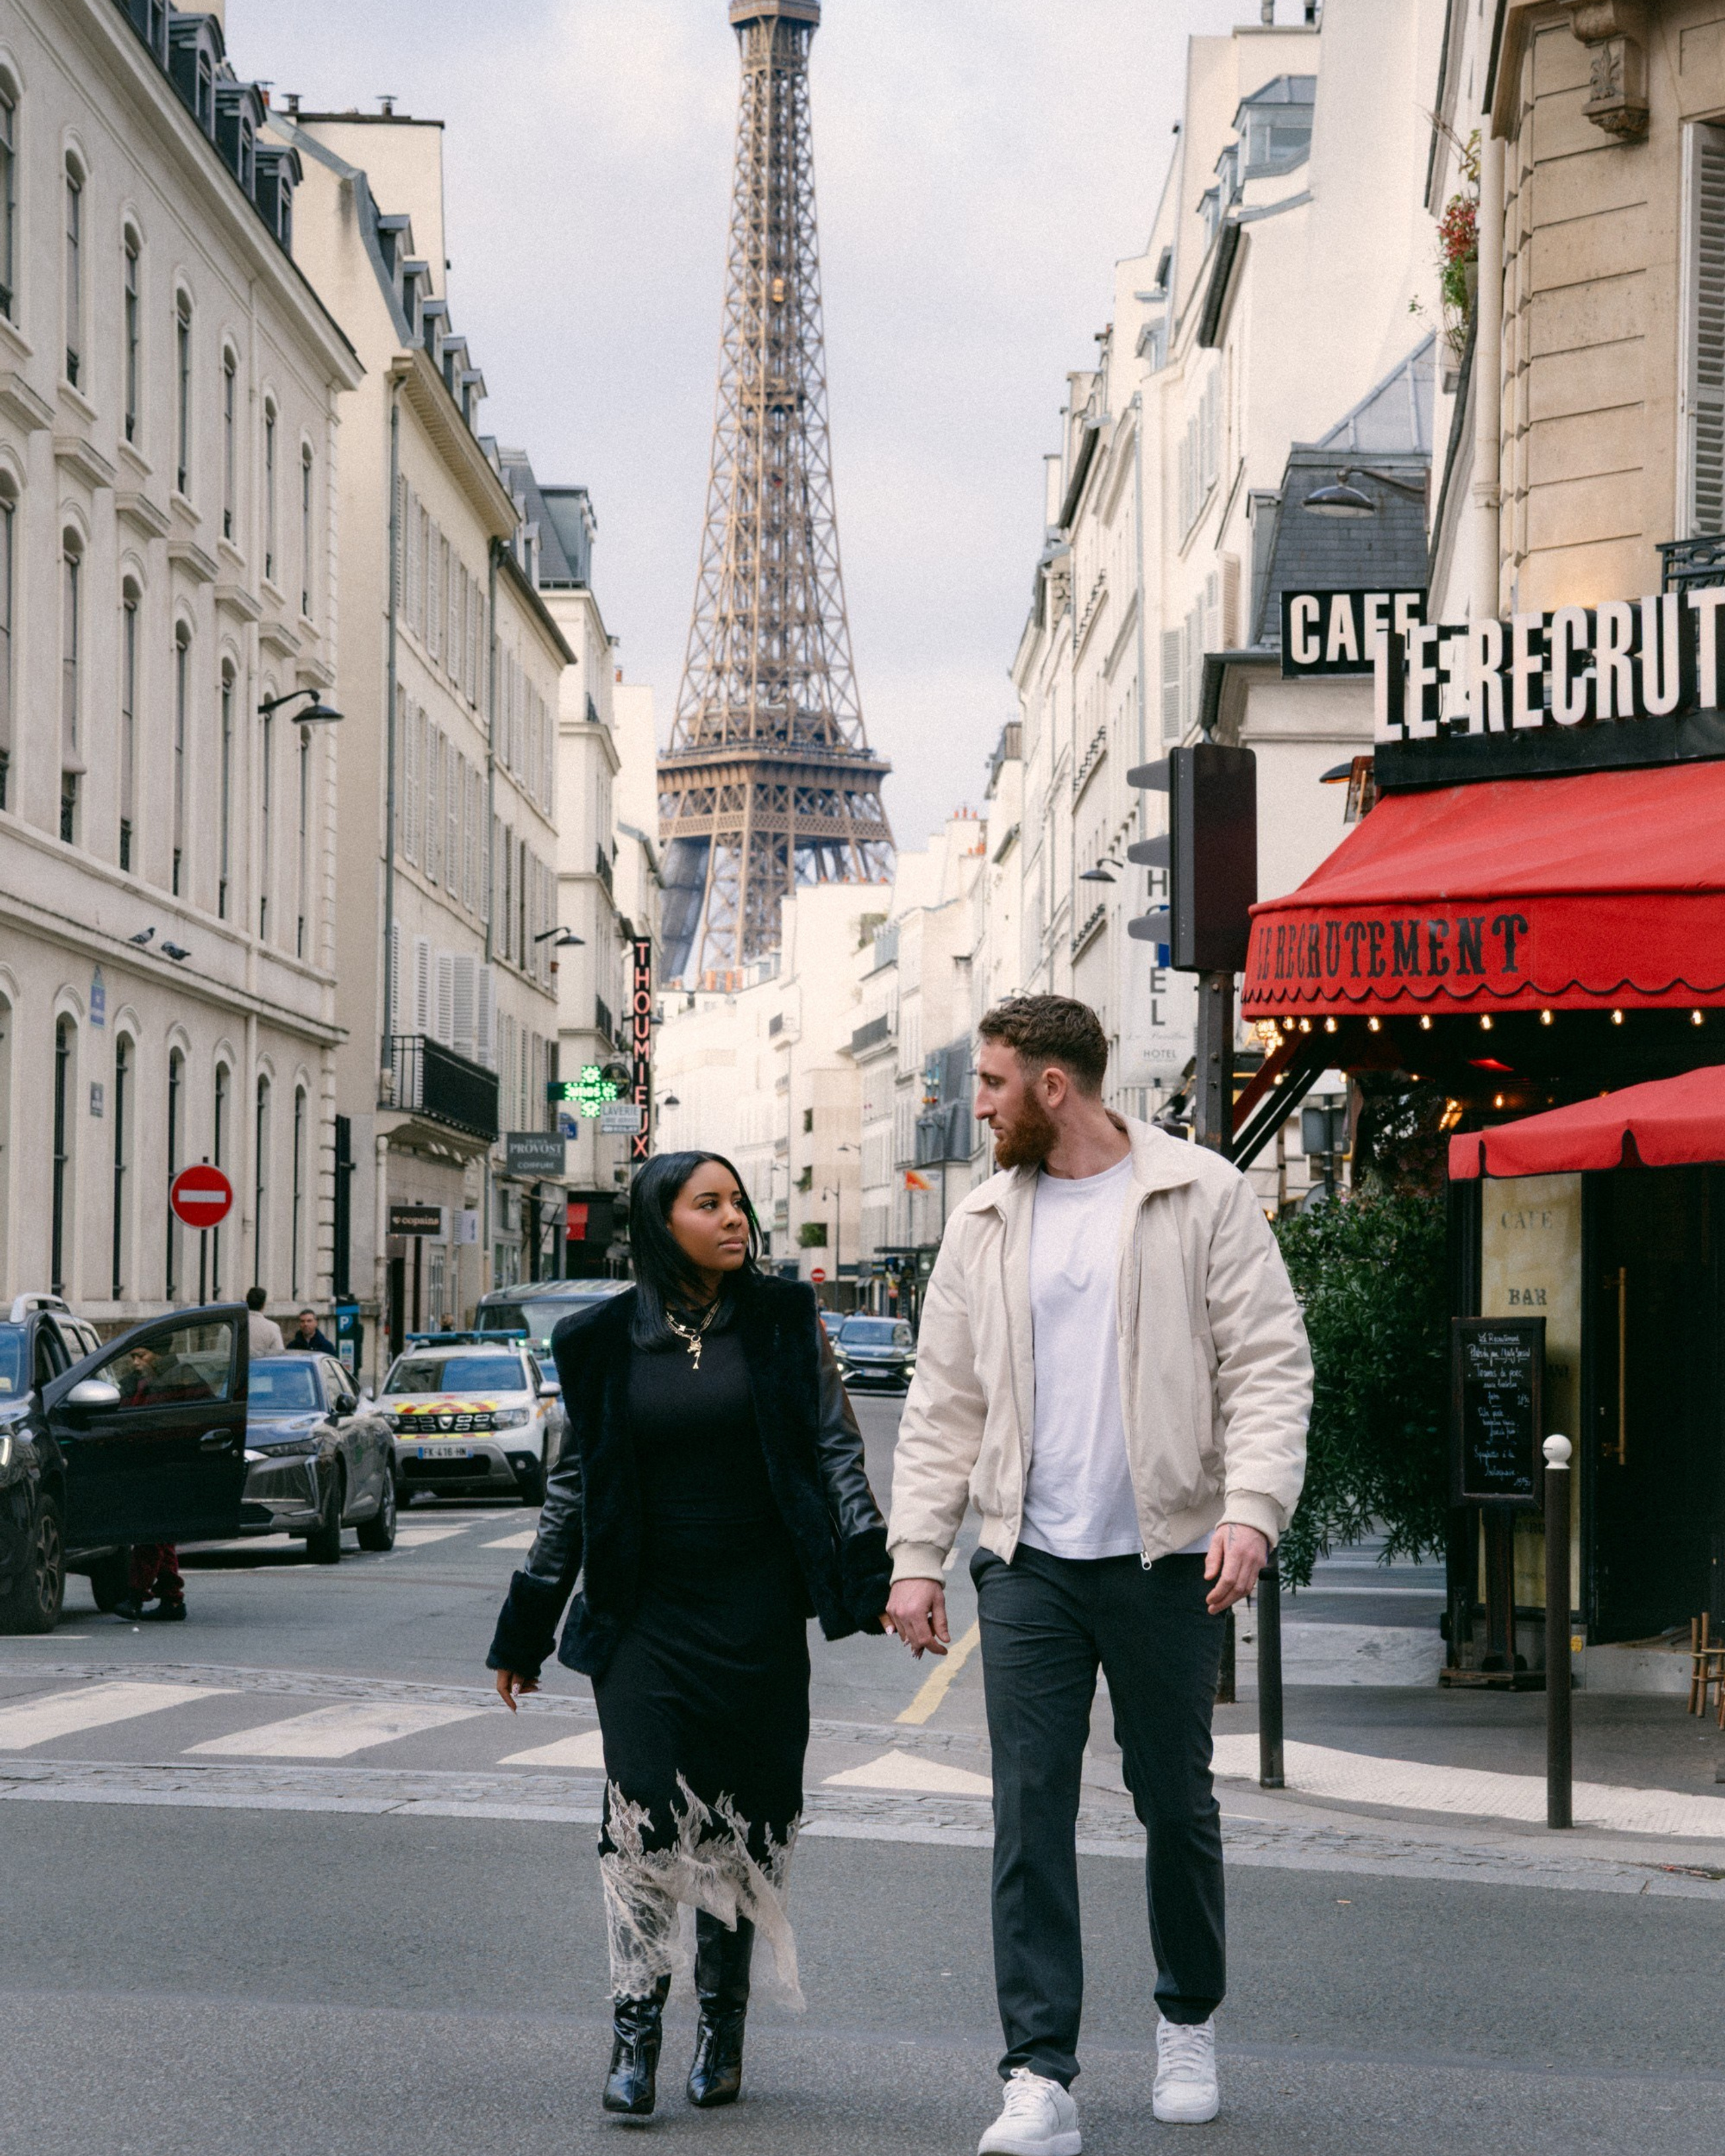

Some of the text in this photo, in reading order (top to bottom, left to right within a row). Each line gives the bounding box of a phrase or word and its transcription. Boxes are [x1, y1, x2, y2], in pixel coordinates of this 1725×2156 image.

[1290, 593, 1420, 664] CAFE
[1374, 586, 1725, 742] LE RECRUT
[1146, 870, 1168, 1025] HEL
[1257, 914, 1528, 980] LE RECRUTEMENT
[1143, 1049, 1177, 1058] HOTEL
[602, 1106, 639, 1116] LAVERIE
[509, 1143, 562, 1154] PROVOST
[517, 1162, 555, 1170] COIFFURE
[1501, 1210, 1552, 1229] CAFE
[1509, 1288, 1547, 1306] BAR
[340, 1316, 349, 1329] P
